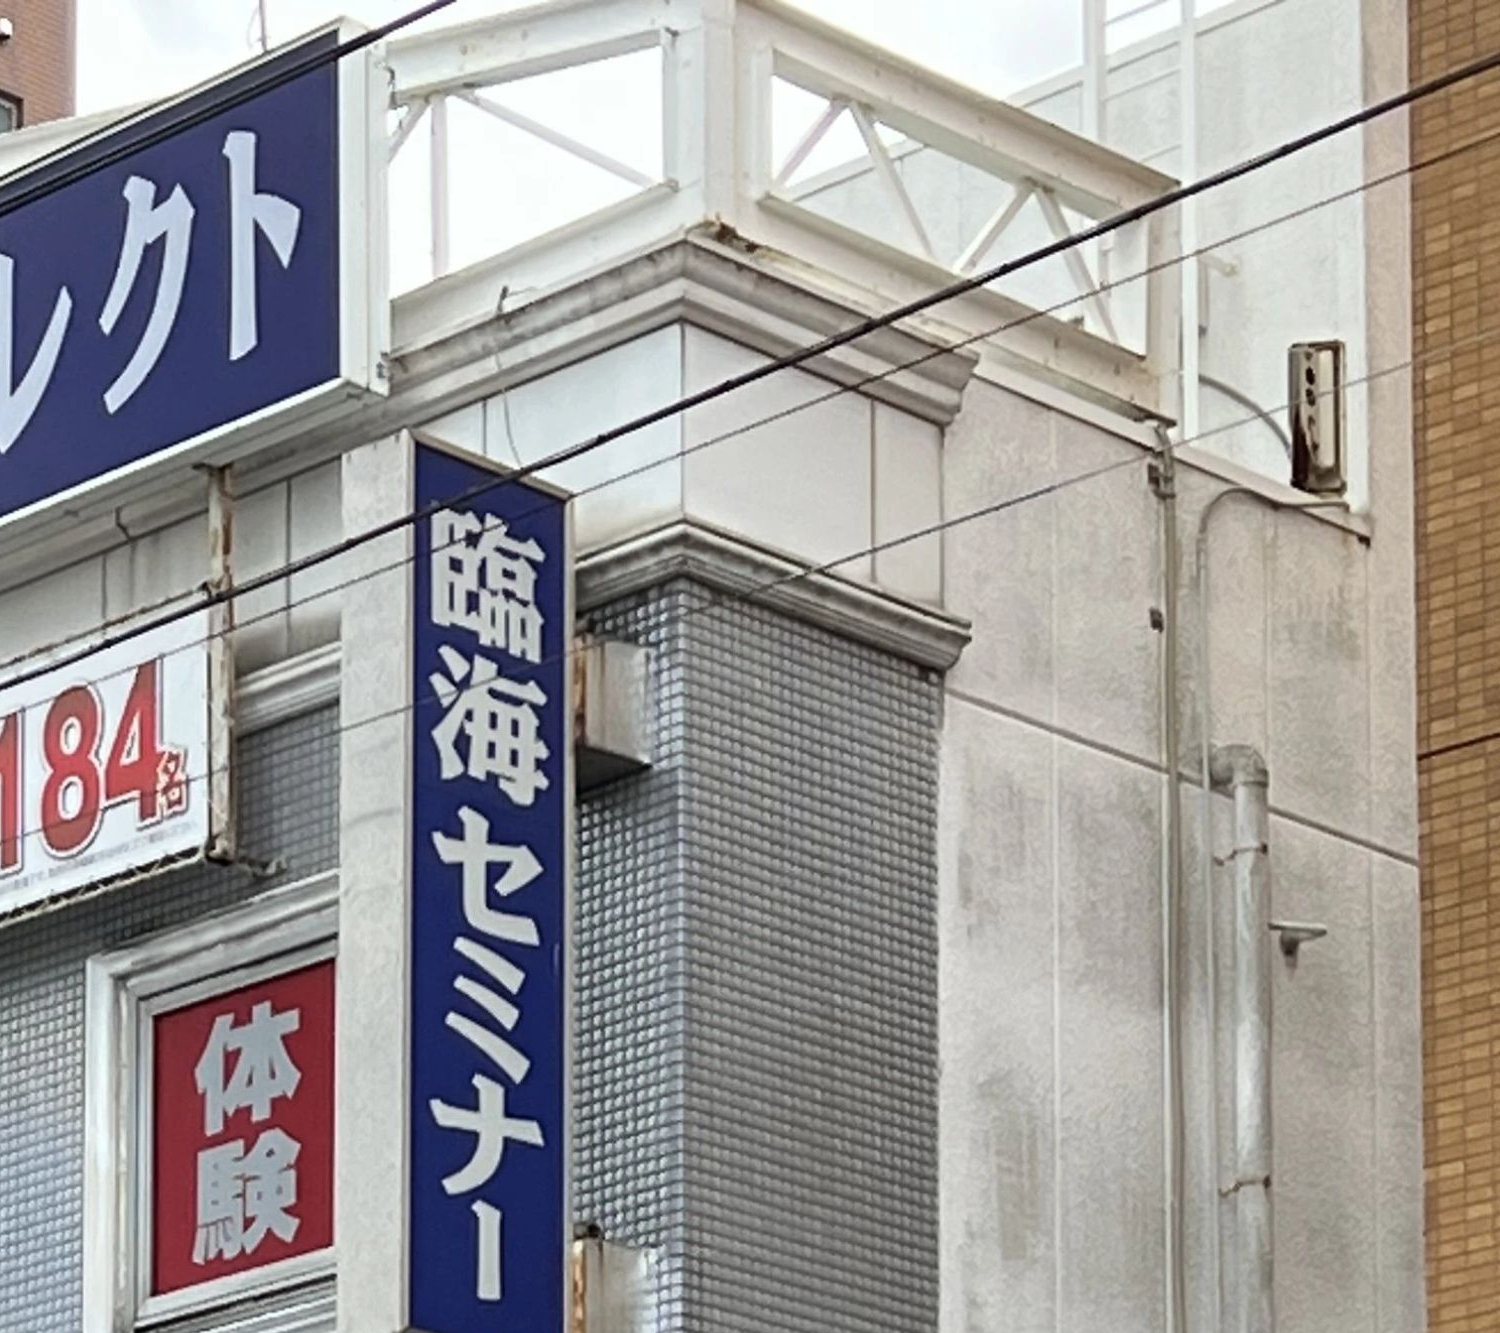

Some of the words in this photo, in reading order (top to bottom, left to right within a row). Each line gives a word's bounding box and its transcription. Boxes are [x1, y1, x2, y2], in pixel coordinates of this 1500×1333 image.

[192, 1000, 302, 1265] 体験
[429, 501, 551, 1303] 臨海セミナー
